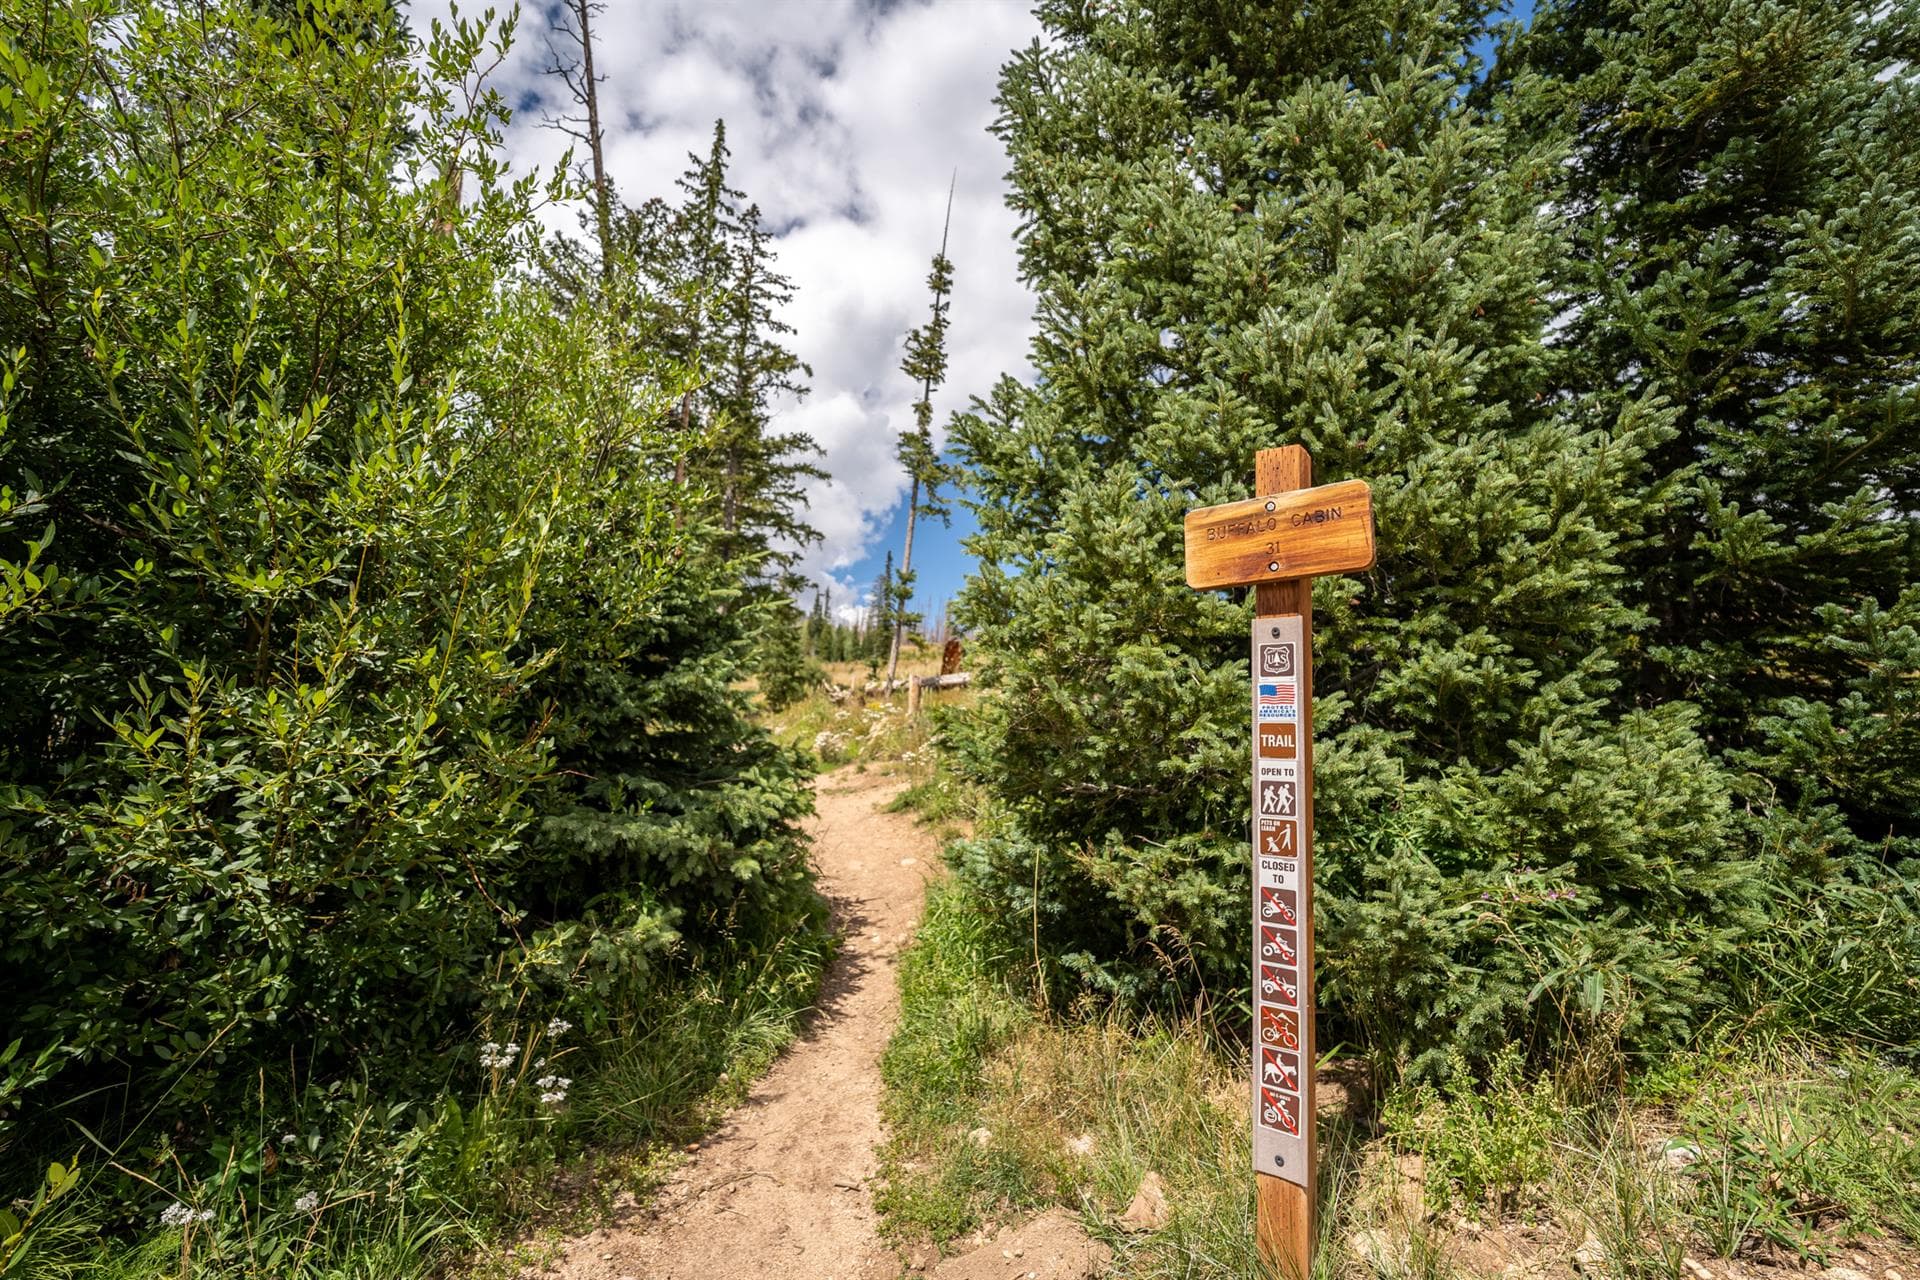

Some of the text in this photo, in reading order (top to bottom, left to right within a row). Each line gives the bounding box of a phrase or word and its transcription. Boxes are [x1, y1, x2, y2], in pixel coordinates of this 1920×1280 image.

[1207, 506, 1342, 541] BUFFALO CABIN
[1265, 541, 1280, 555] 31
[1261, 734, 1295, 747] TRAIL
[1261, 767, 1294, 776] OPEN TO
[1262, 860, 1295, 872] CLOSED
[1273, 874, 1284, 884] TO
